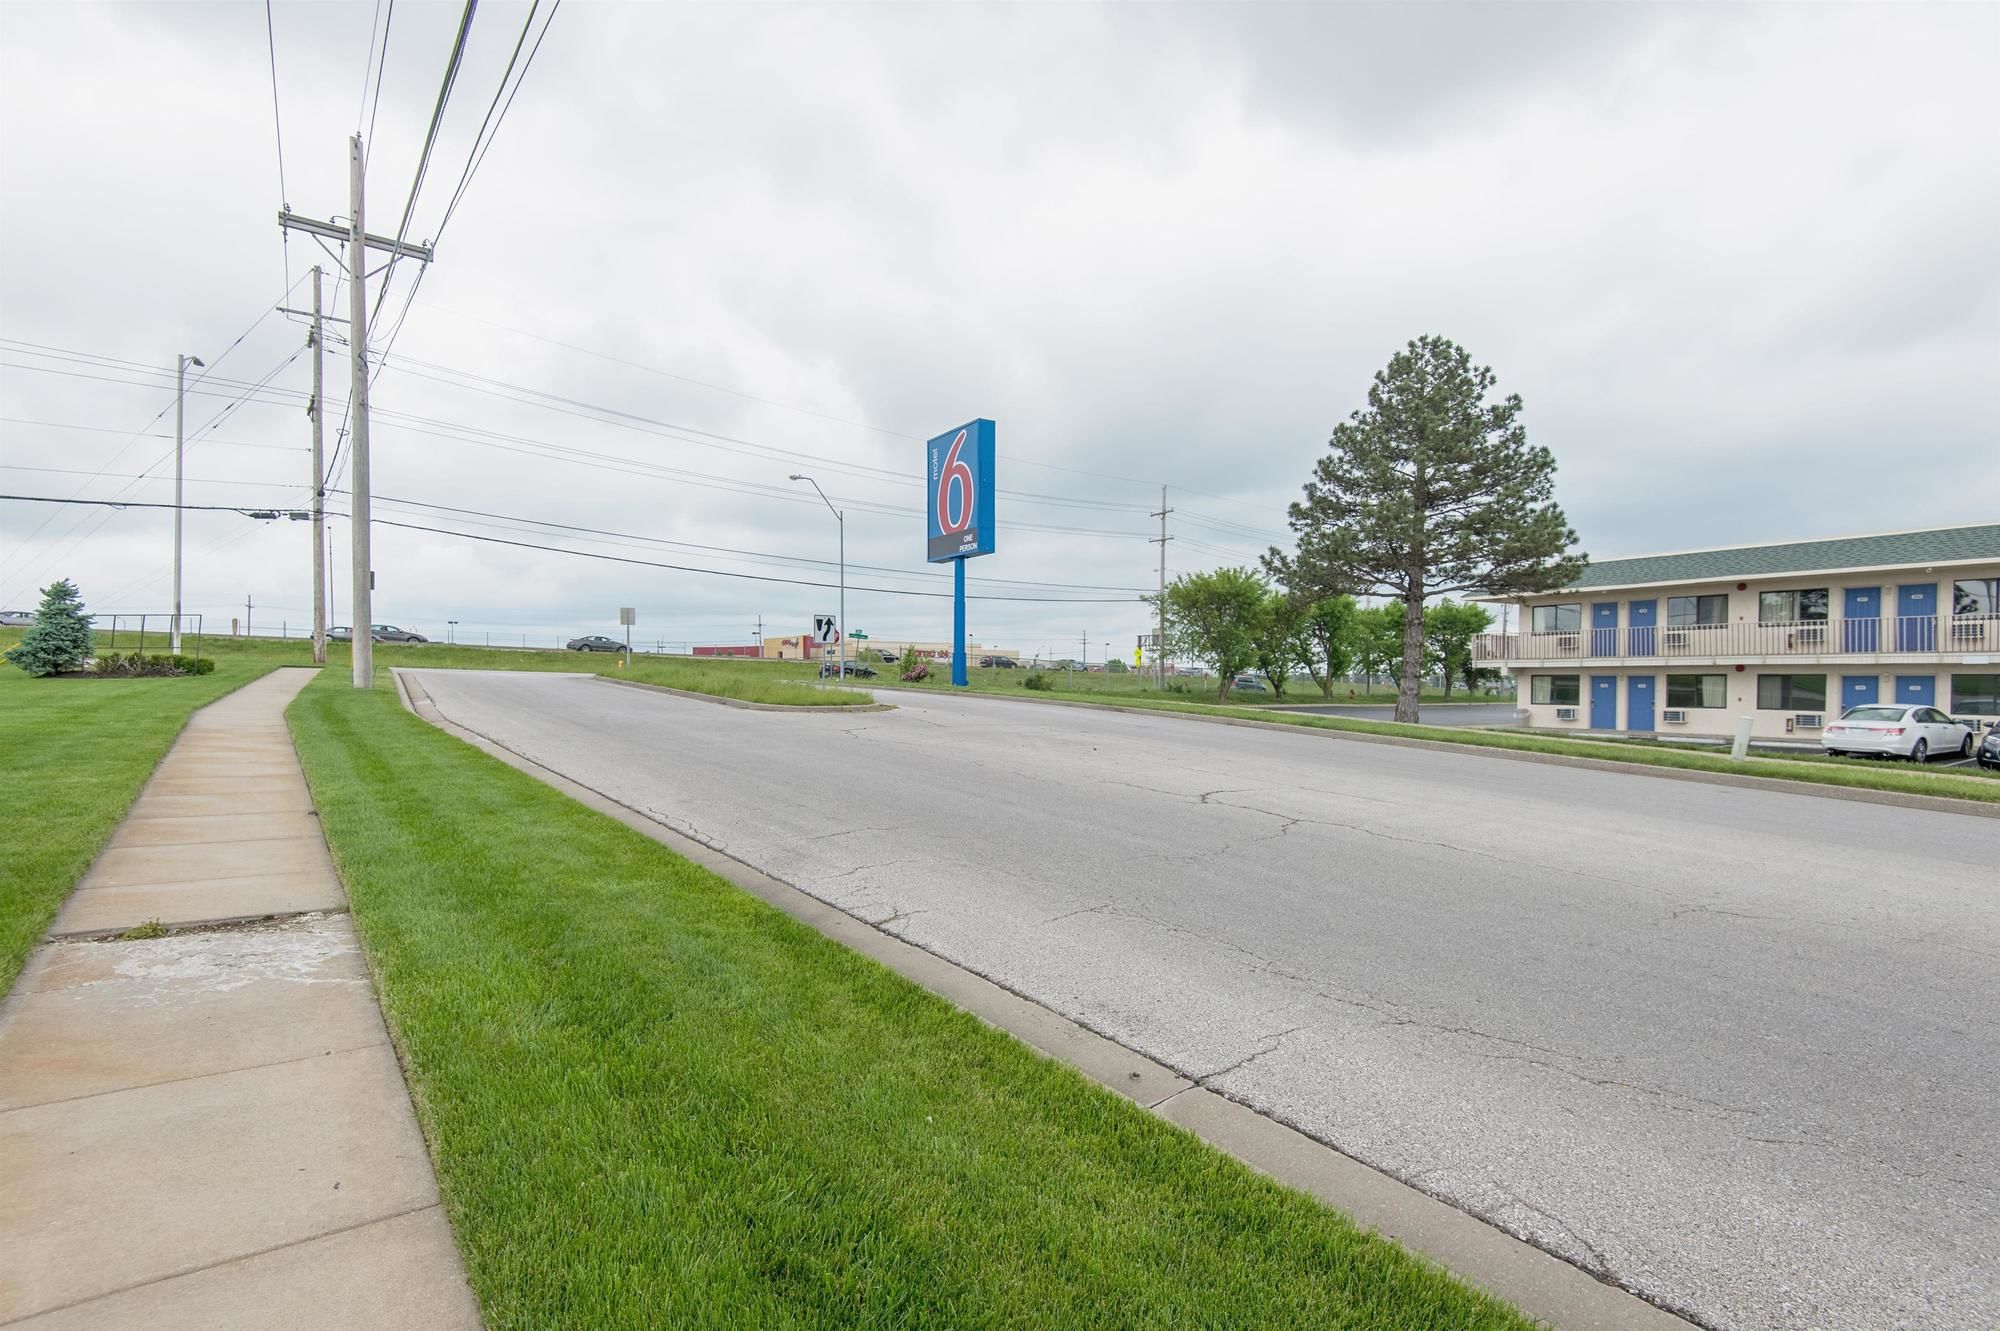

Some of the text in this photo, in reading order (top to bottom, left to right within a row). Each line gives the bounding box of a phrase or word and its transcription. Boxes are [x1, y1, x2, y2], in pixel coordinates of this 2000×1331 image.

[937, 429, 974, 535] 6
[963, 533, 974, 543] ONE
[959, 542, 978, 553] PERSON
